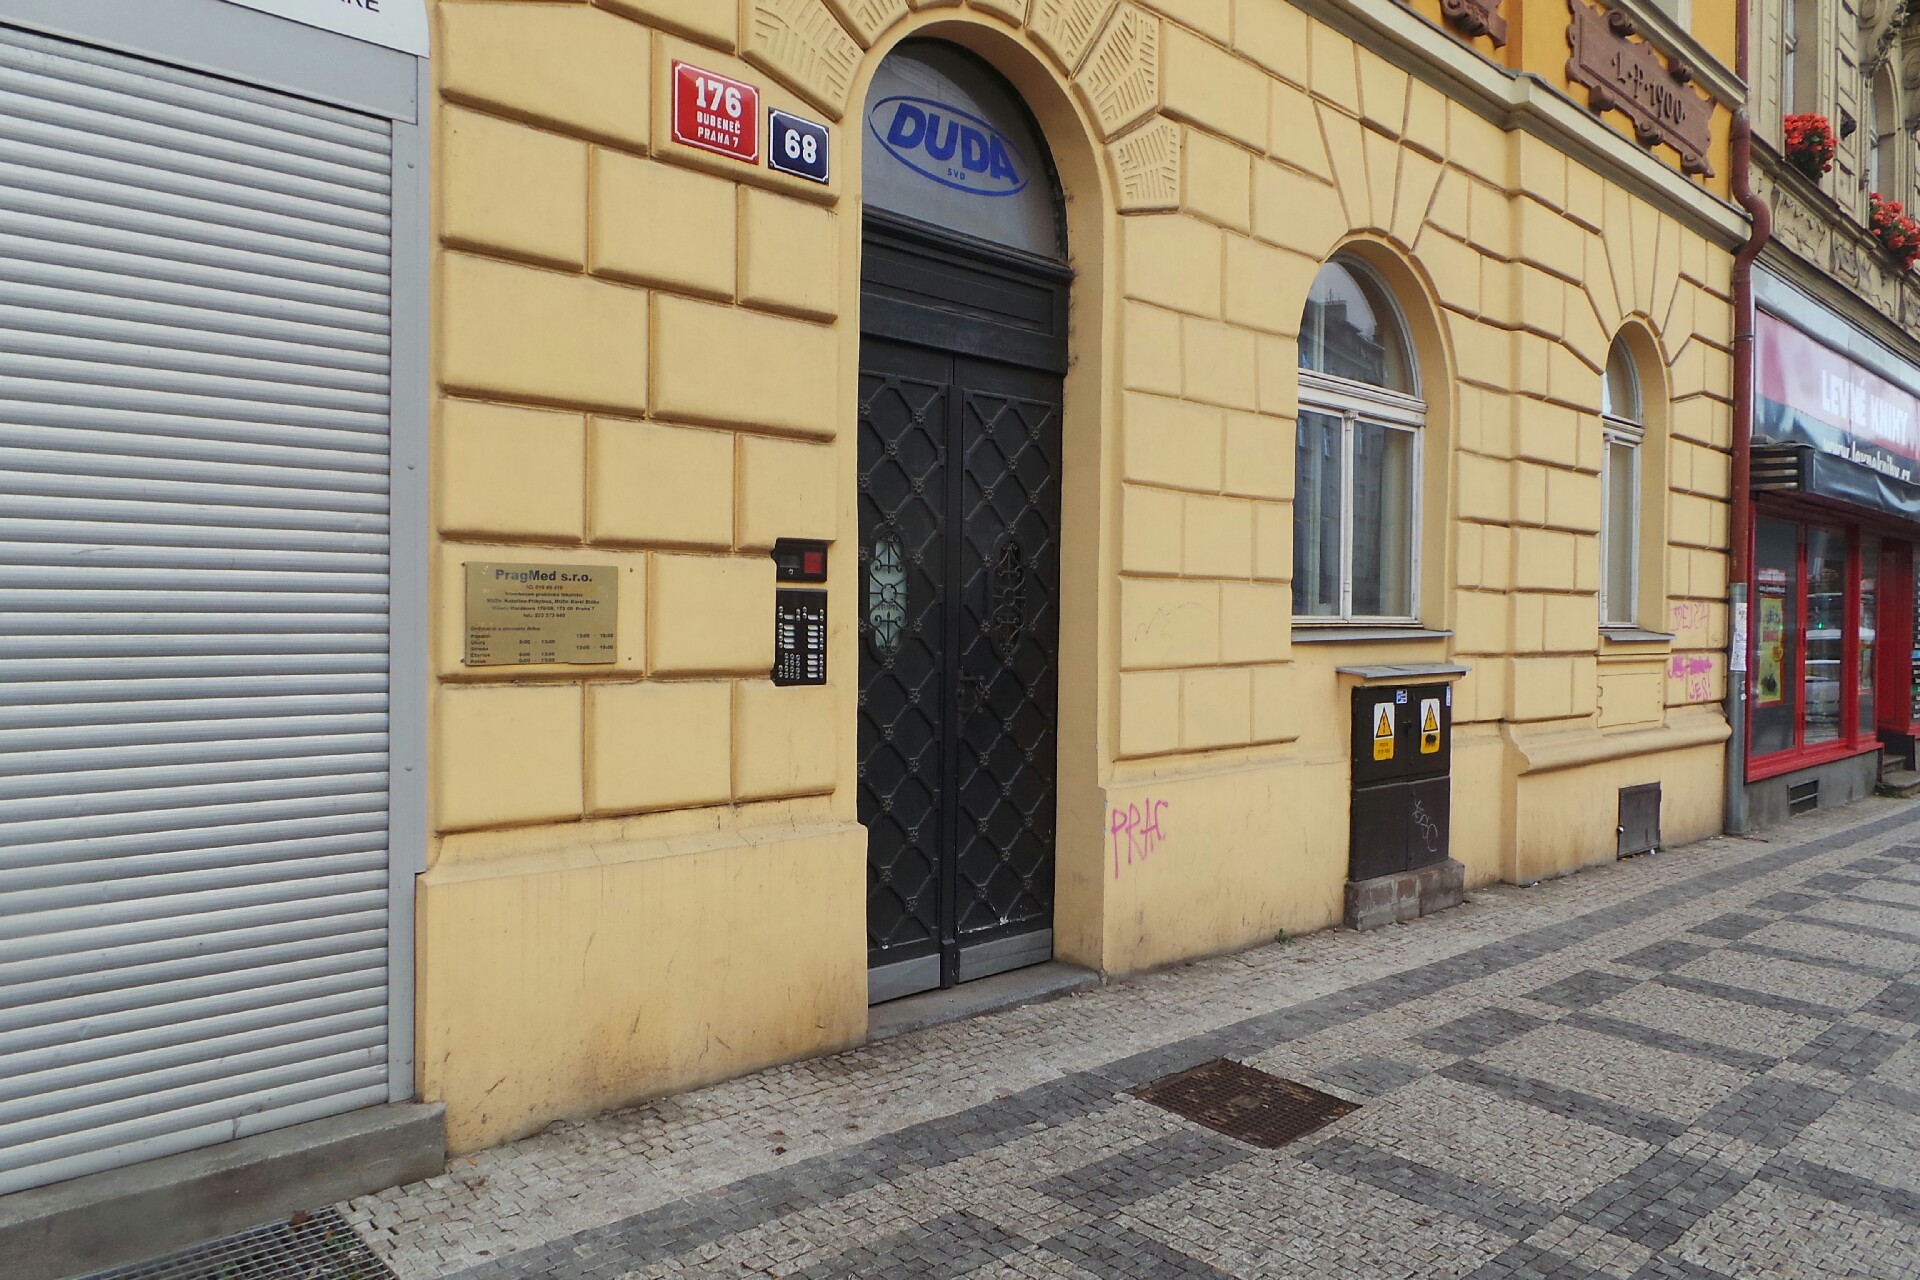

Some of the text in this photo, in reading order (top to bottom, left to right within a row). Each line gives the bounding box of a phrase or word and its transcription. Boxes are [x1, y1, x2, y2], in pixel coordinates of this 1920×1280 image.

[695, 76, 742, 118] 176
[696, 110, 741, 135] BUBENEČ
[697, 126, 739, 148] PRAHA 7
[784, 128, 817, 164] 68
[886, 102, 1020, 186] DUDA
[947, 167, 966, 181] SVD
[1821, 368, 1909, 446] LEVNÉ KNIHY
[495, 568, 593, 583] PragMed s.r.o.
